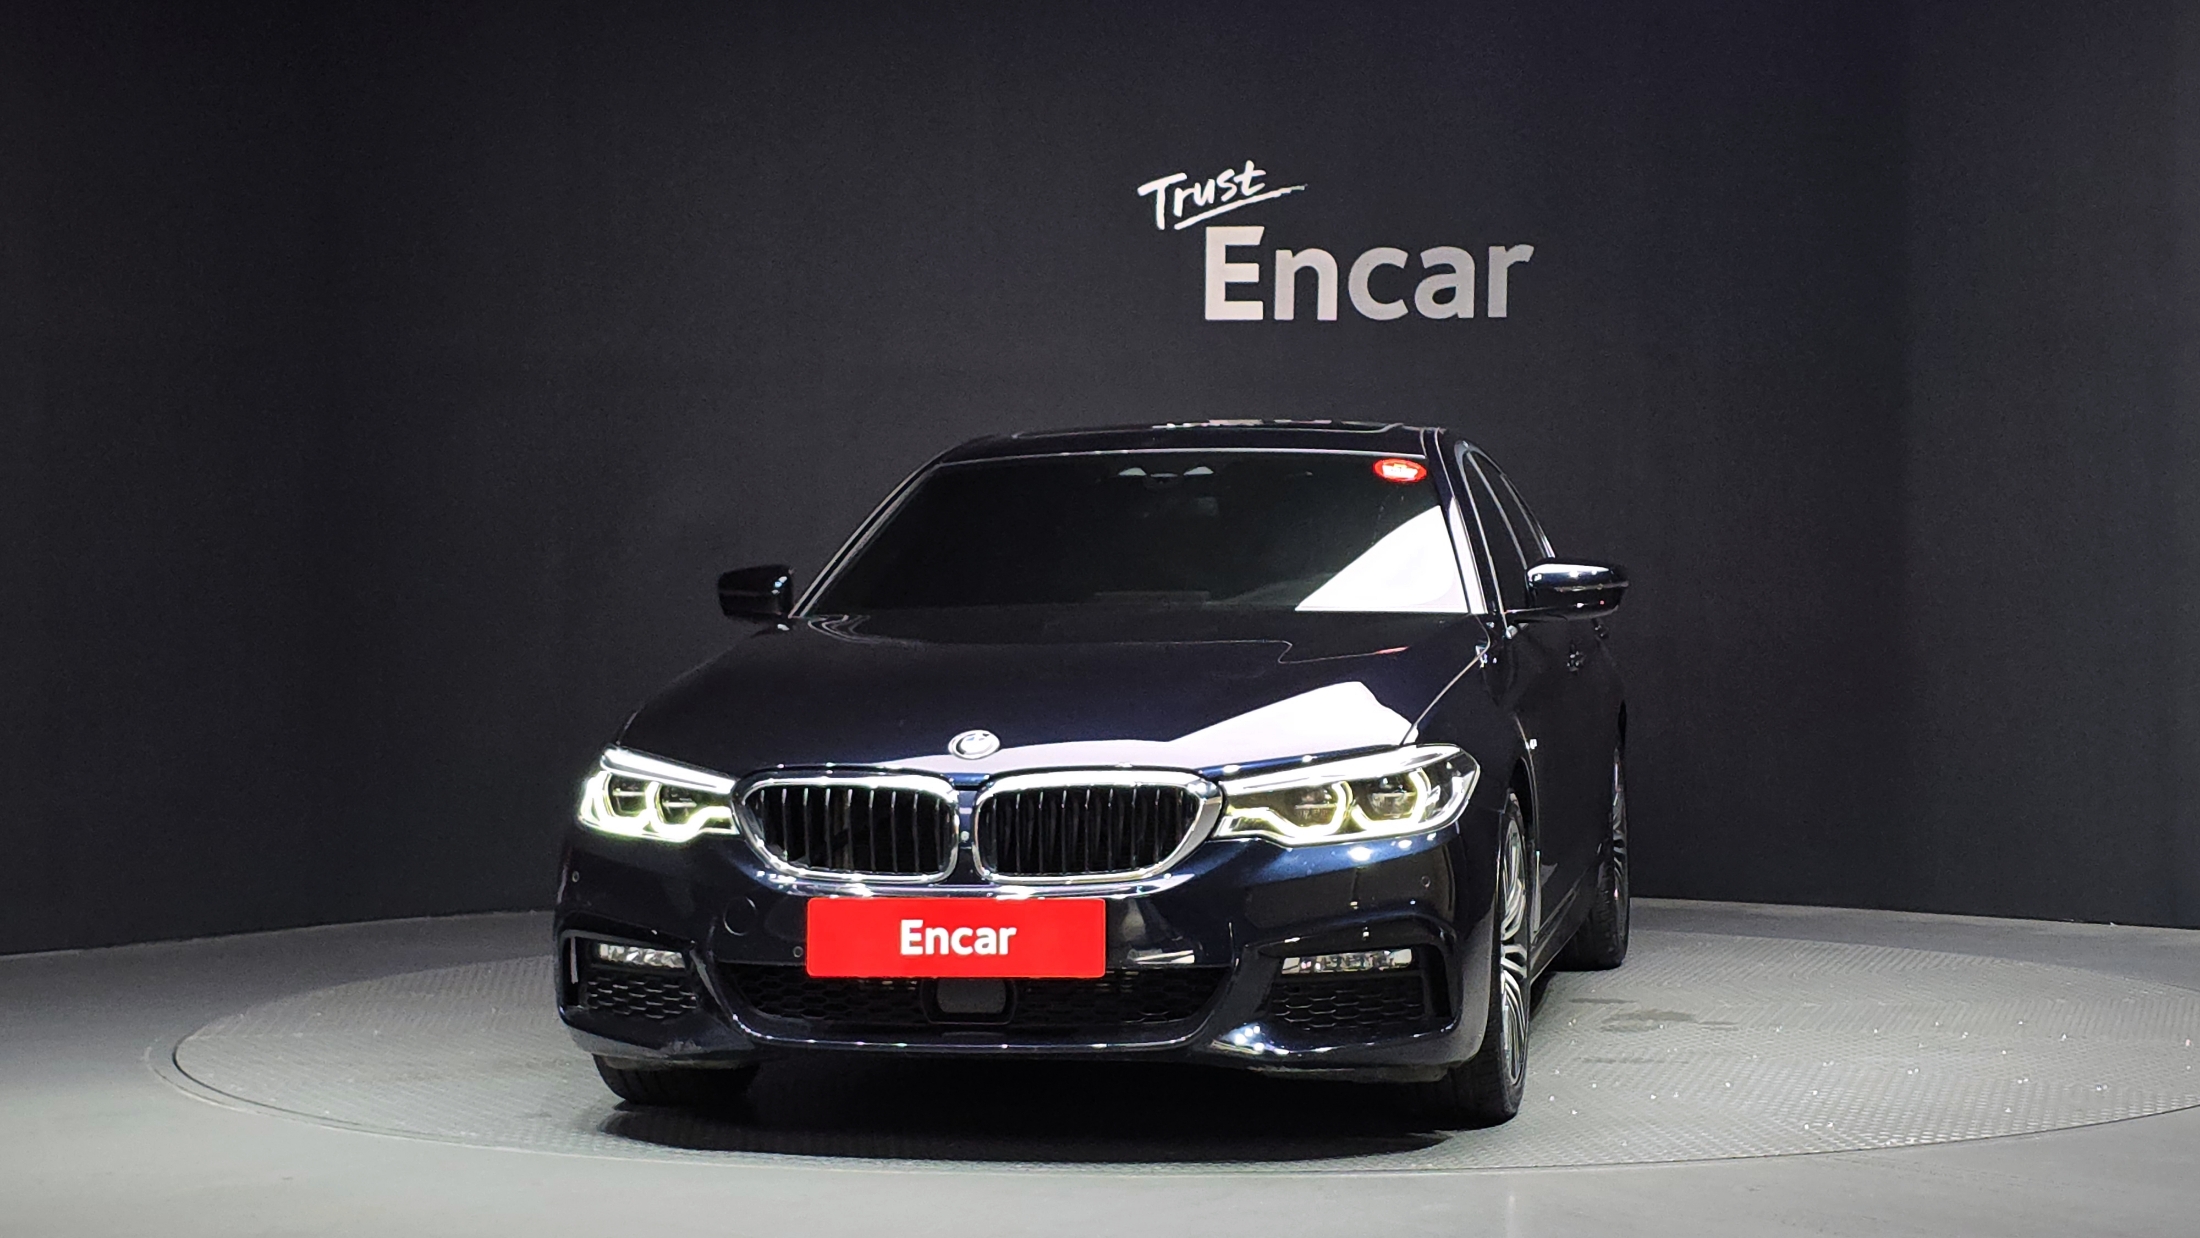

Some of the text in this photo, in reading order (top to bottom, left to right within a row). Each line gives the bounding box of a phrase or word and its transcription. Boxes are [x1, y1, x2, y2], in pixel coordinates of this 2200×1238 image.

[1137, 160, 1267, 230] Trust
[1205, 226, 1534, 321] Encar
[900, 919, 1017, 955] Encar
